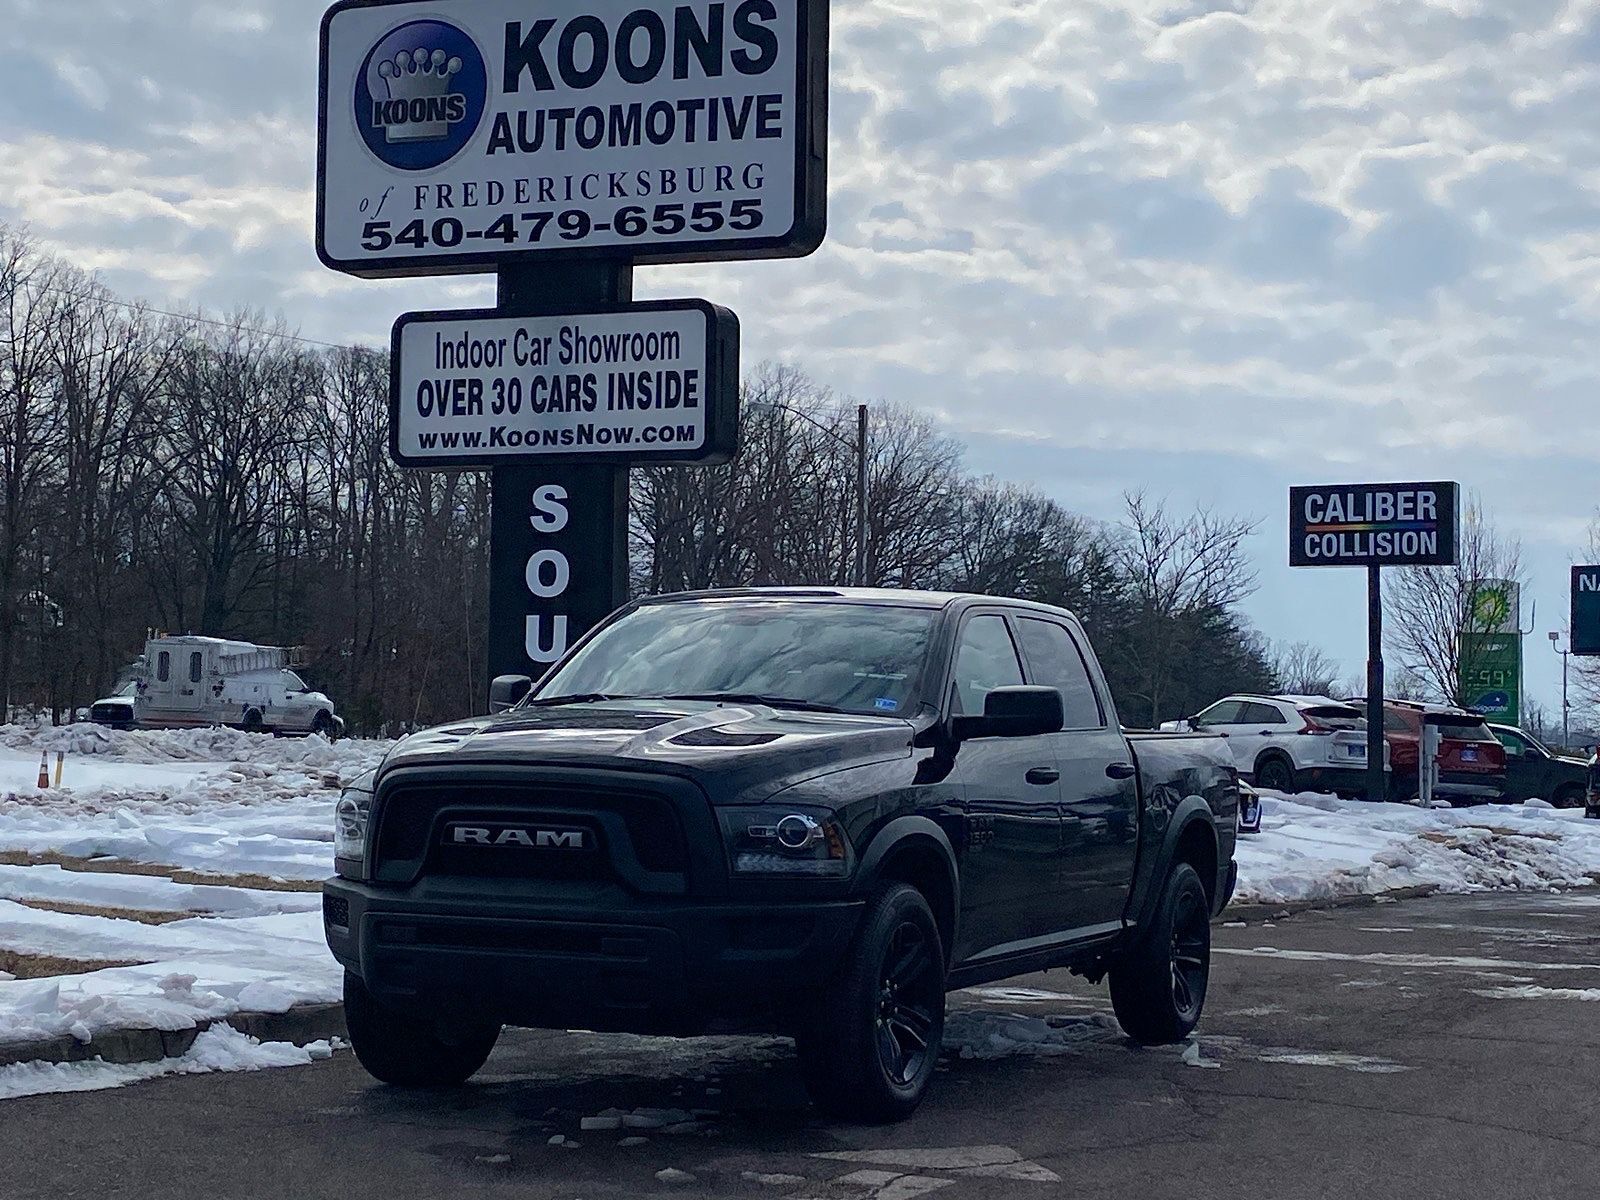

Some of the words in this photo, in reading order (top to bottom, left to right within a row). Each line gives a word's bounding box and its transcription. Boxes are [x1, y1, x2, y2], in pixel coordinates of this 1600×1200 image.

[503, 0, 779, 93] KOONS
[372, 94, 466, 127] KOONS
[486, 94, 783, 156] AUTOMOTIVE
[358, 185, 395, 220] of
[414, 163, 766, 210] FREDERICKSBURG
[360, 199, 764, 251] 540-479-6555
[435, 331, 507, 370] Indoor
[513, 327, 552, 367] Car
[558, 325, 681, 365] Showroom
[416, 378, 484, 418] OVER
[491, 376, 523, 415] 30
[530, 373, 598, 414] CARS
[607, 369, 700, 411] INSIDE
[1304, 491, 1437, 523] CALIBER
[1304, 531, 1437, 558] COLLISION
[453, 825, 584, 848] RAM
